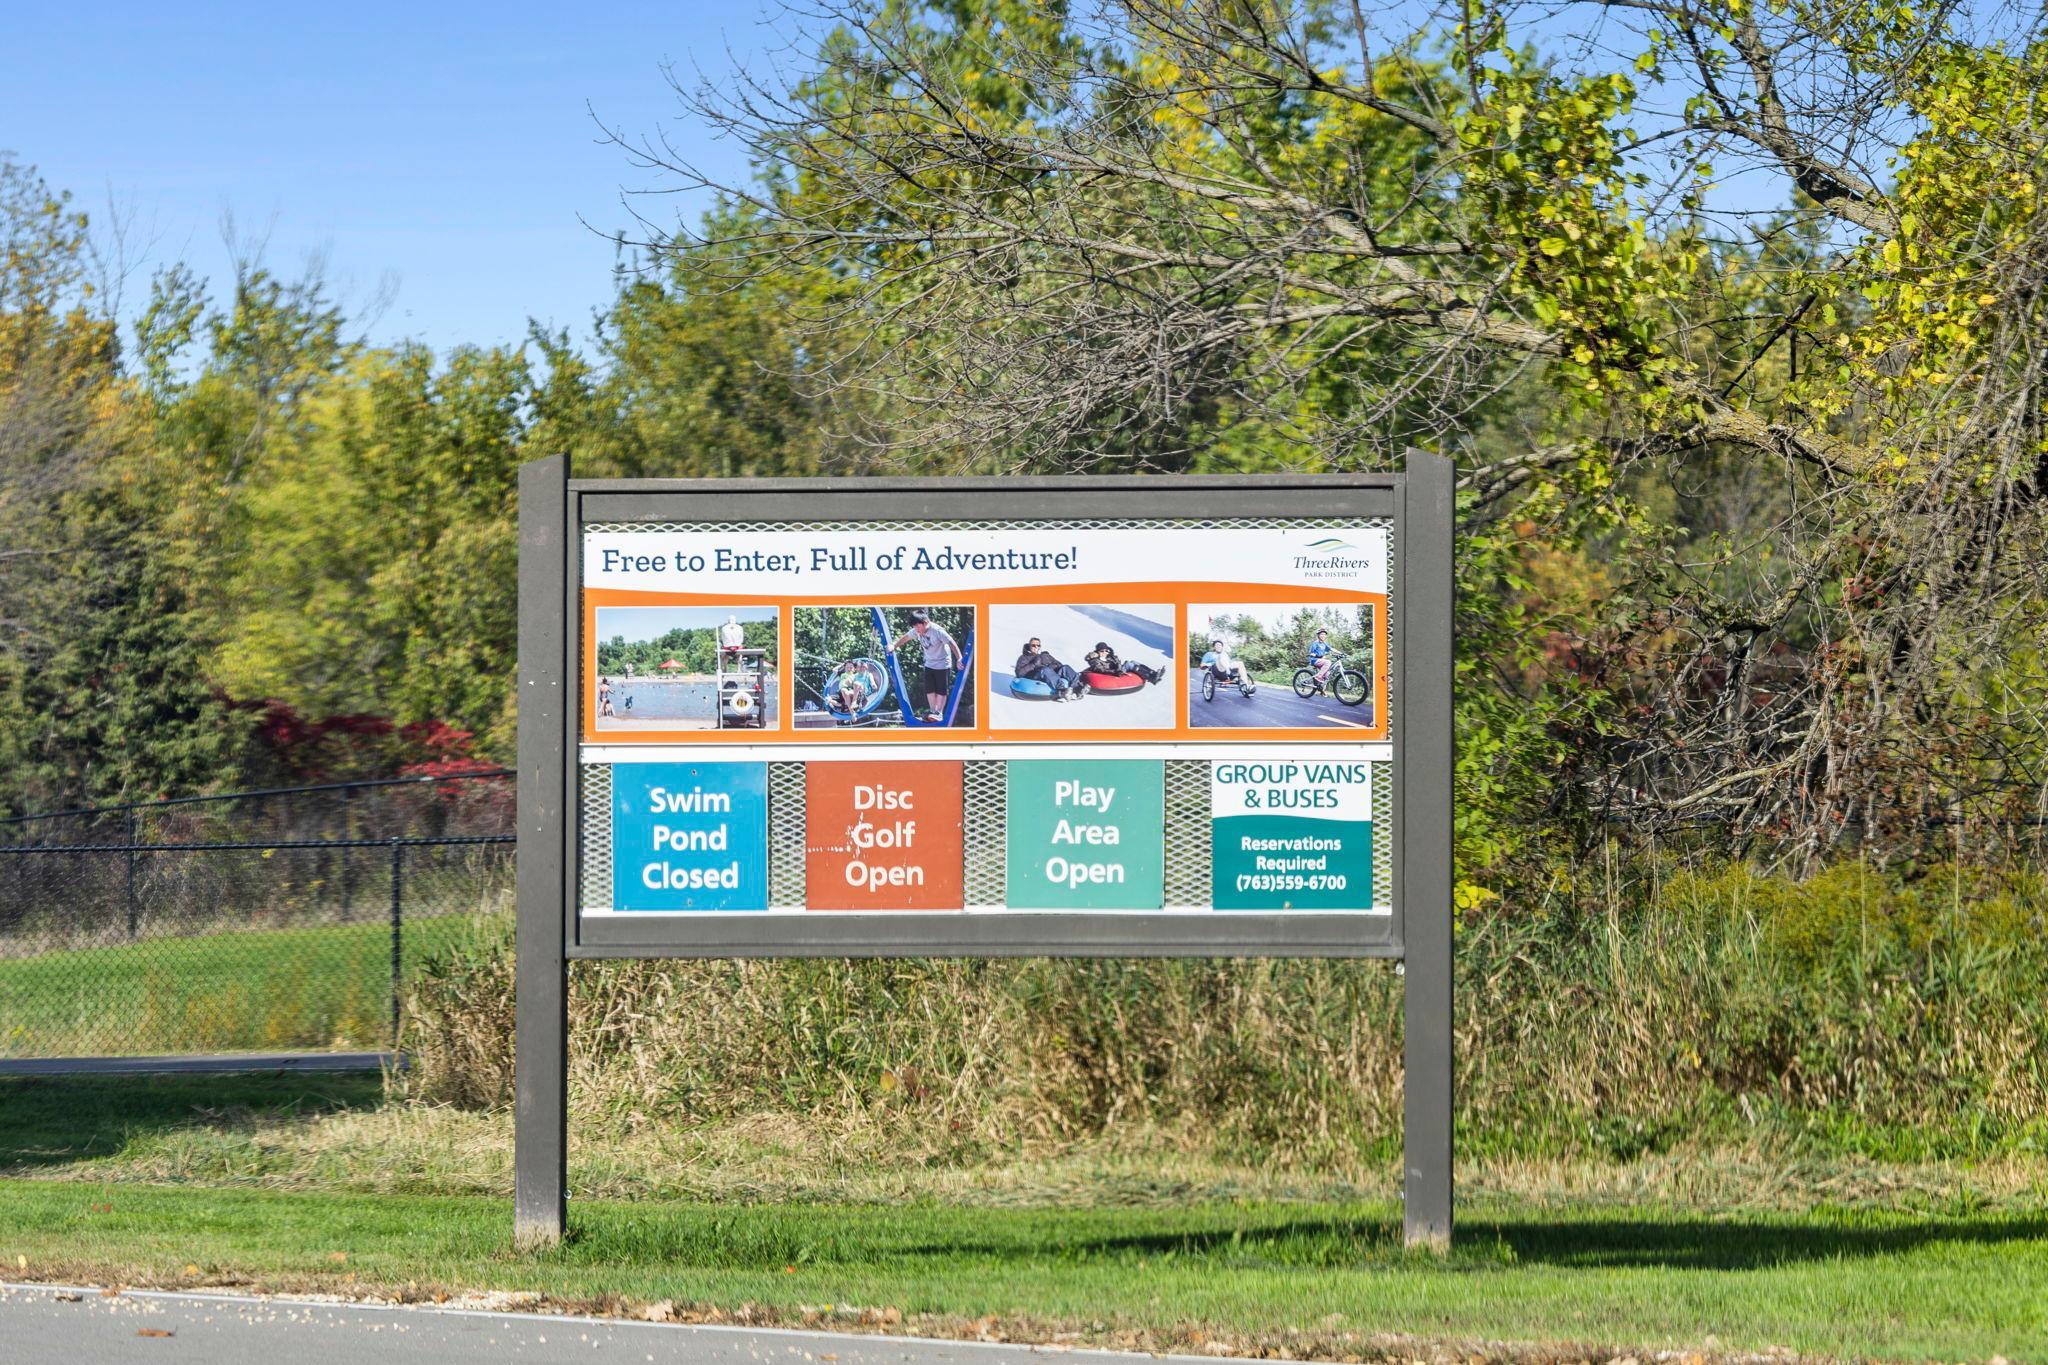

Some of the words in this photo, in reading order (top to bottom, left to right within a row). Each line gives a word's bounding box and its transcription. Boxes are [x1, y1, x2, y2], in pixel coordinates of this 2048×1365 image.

[602, 549, 666, 572] Free
[675, 551, 705, 572] to
[714, 548, 801, 574] Enter,
[810, 547, 867, 571] Full
[875, 546, 906, 571] of
[912, 546, 1077, 570] Adventure!
[1216, 764, 1298, 784] GROUP
[1304, 764, 1366, 784] VANS
[650, 787, 730, 813] Swim
[854, 784, 913, 810] Disc
[1055, 780, 1115, 812] Play
[1244, 789, 1261, 808] &
[1268, 788, 1339, 808] BUSES
[653, 826, 727, 851] Pond
[853, 821, 915, 849] Golf
[1051, 820, 1119, 845] Area
[1241, 836, 1341, 851] Reservations
[642, 862, 739, 889] Closed
[845, 860, 924, 891] Open
[1045, 857, 1124, 889] Open
[1256, 855, 1326, 872] Required
[1236, 874, 1346, 891] (763)559-6700
